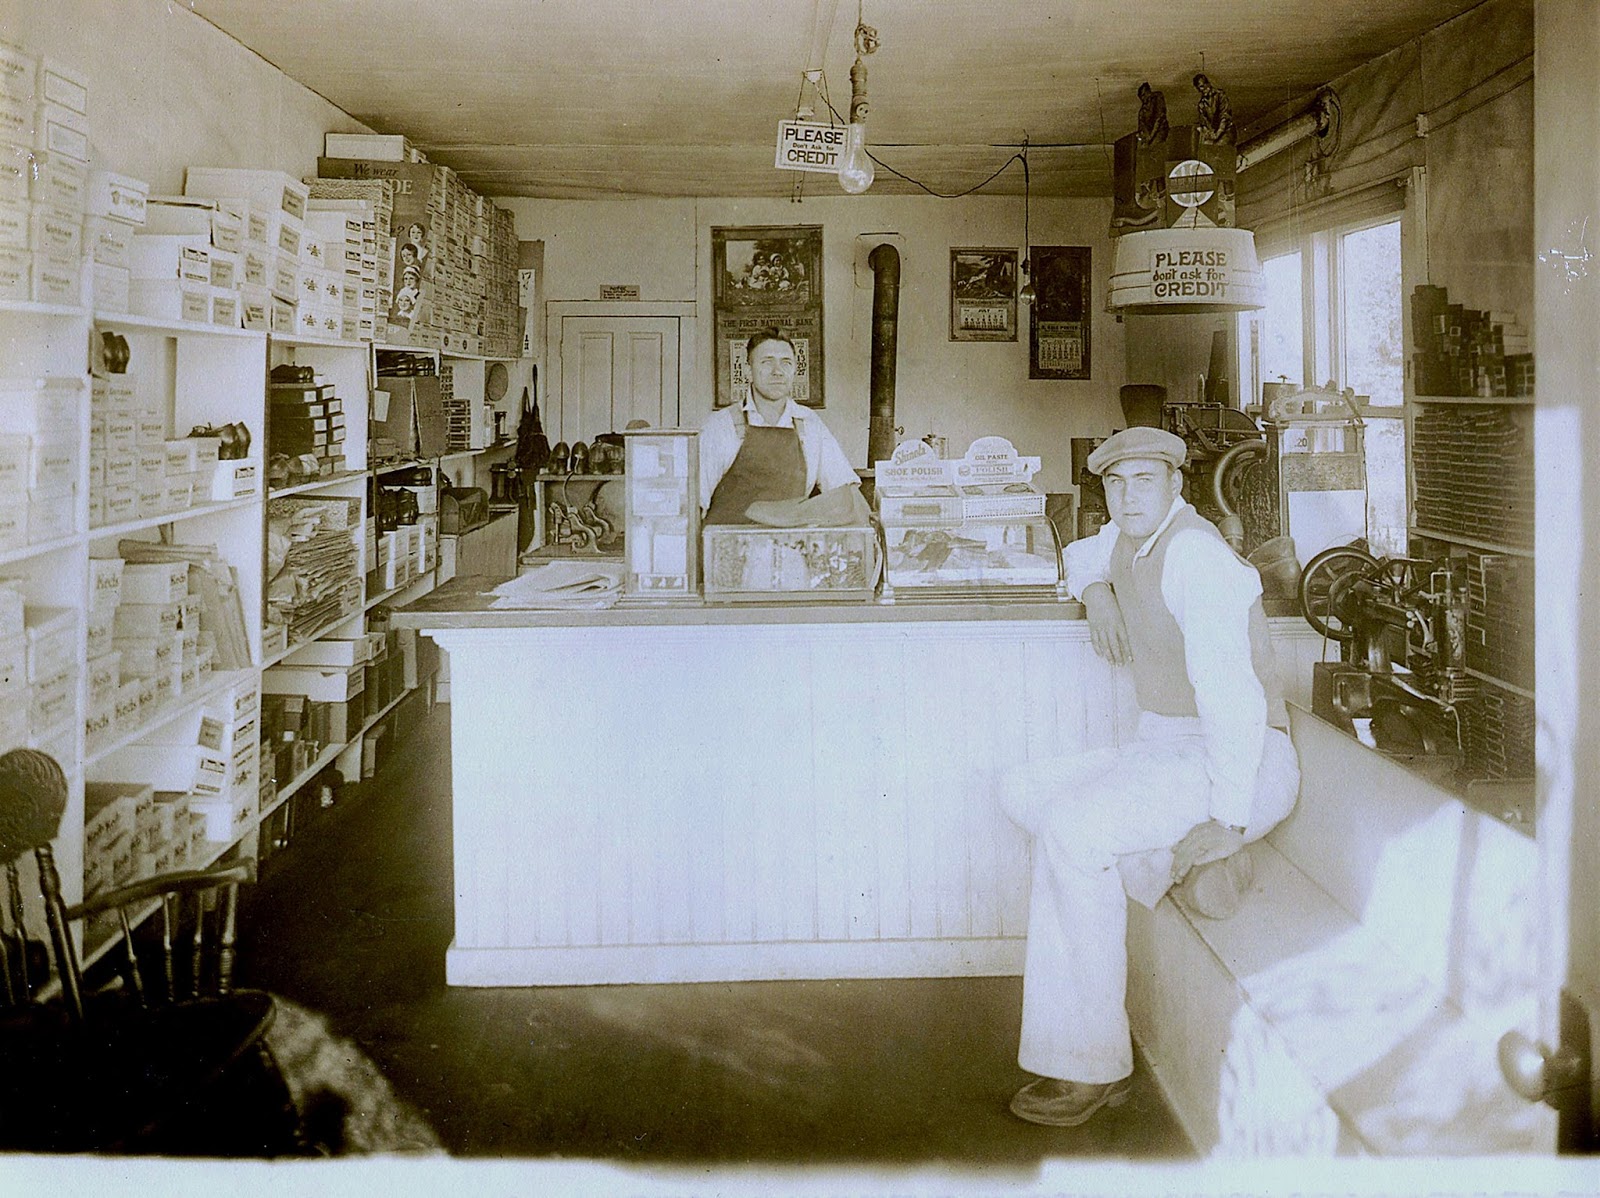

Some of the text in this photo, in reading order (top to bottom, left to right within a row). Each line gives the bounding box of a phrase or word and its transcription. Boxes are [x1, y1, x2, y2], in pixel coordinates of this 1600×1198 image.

[785, 128, 845, 145] PLEASE
[787, 149, 839, 165] CREDIT
[354, 163, 399, 176] We wear
[1155, 251, 1227, 267] PLEASE
[1180, 268, 1202, 280] ask
[1206, 269, 1225, 280] for
[1154, 281, 1230, 298] CREDIT
[761, 319, 793, 327] NATIONAL
[796, 318, 813, 326] BANK
[736, 355, 741, 363] 7
[885, 467, 943, 477] SHOE POLISH
[97, 573, 119, 590] Keds
[170, 574, 186, 586] Keds
[115, 699, 138, 719] Keds
[86, 714, 109, 734] Keds
